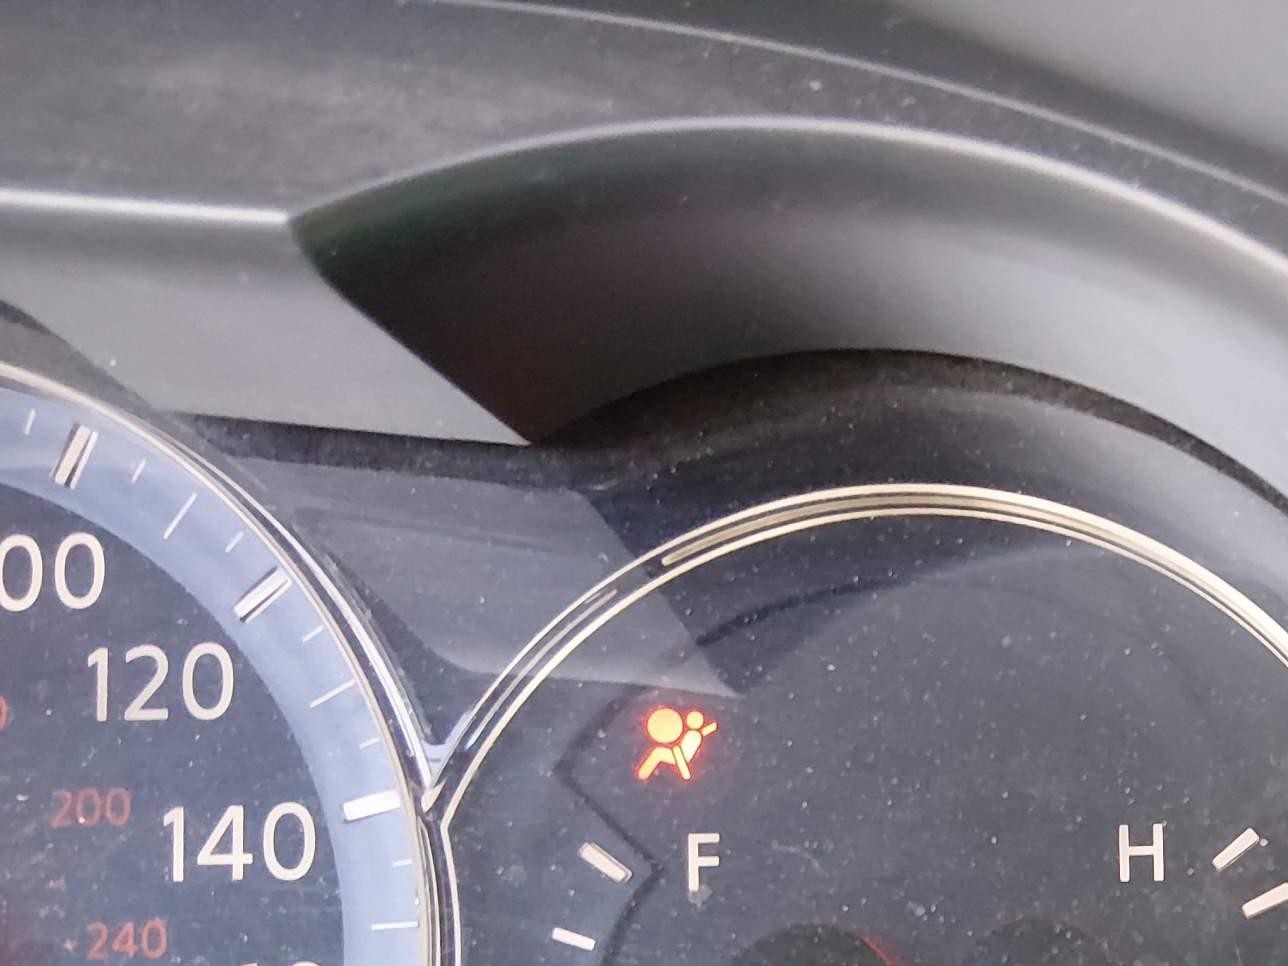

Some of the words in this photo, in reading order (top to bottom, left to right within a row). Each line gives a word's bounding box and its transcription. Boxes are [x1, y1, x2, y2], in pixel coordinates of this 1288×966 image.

[87, 642, 235, 722] 120
[50, 786, 133, 829] 200
[163, 802, 316, 883] 140
[688, 832, 721, 892] F
[1118, 823, 1165, 883] H
[86, 919, 168, 961] 240
